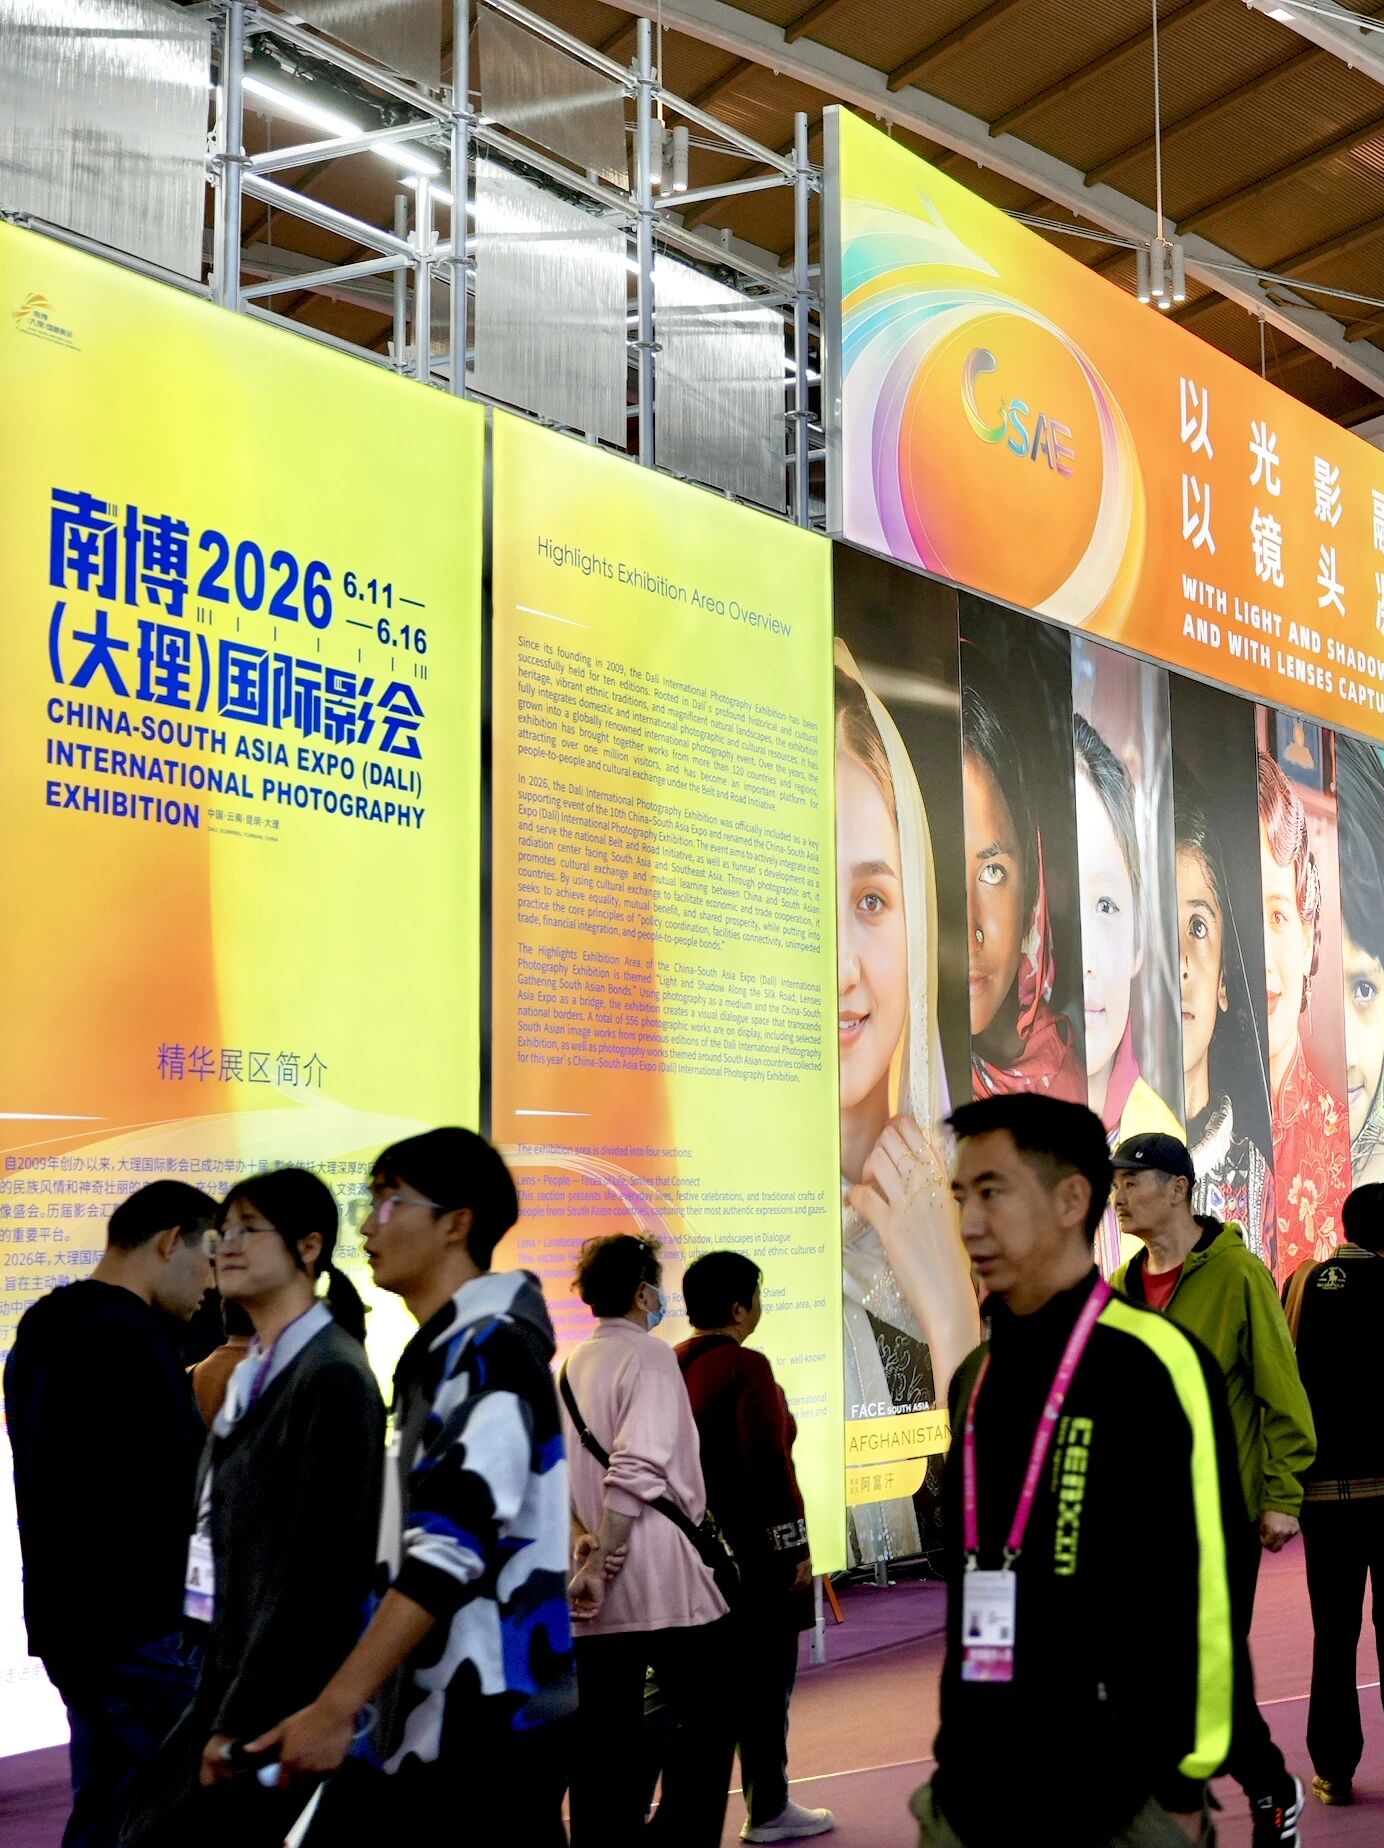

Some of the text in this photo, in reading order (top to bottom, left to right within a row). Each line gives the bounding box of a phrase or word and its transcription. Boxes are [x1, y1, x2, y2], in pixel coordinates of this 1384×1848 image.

[197, 529, 333, 629] 2026
[538, 536, 793, 638] Highlights Exhibition Area Overview
[1181, 573, 1228, 616] WITH
[1234, 597, 1283, 638] LIGHT
[1288, 621, 1321, 654] AND
[518, 636, 539, 651] Since
[543, 643, 552, 655] its
[557, 646, 591, 668] founding
[606, 660, 625, 676] 2009,
[629, 667, 641, 679] the
[645, 671, 658, 684] Dali
[663, 676, 706, 698] International
[710, 690, 751, 713] Photography
[755, 703, 786, 721] Exhibition
[788, 714, 799, 725] has
[802, 718, 817, 731] been
[1183, 613, 1221, 649] AND
[1227, 630, 1271, 669] WITH
[1277, 651, 1333, 693] LENSES
[47, 697, 423, 800] CHINA-SOUTH ASIA EXPO (DALI)
[518, 665, 817, 756] heritage, vibrant ethnic traditions, and magnificent natural landscapes, the exhibition
[47, 738, 425, 829] INTERNATIONAL PHOTOGRAPHY
[518, 710, 818, 797] exhibition has brought together works from more than 120 countries and regions,
[518, 726, 556, 747] attracting
[561, 739, 578, 749] over
[583, 744, 597, 753] one
[603, 745, 628, 761] million
[633, 753, 660, 770] visitors,
[666, 760, 679, 773] and
[683, 765, 695, 777] has
[700, 769, 726, 784] become
[744, 780, 775, 799] important
[779, 789, 806, 807] platform
[809, 797, 818, 808] for
[46, 780, 200, 828] EXHIBITION
[529, 774, 549, 790] 2026,
[553, 779, 565, 791] the
[568, 782, 583, 795] Dali
[586, 786, 633, 806] International
[636, 797, 681, 818] Photography
[684, 807, 717, 824] Exhibition
[720, 818, 732, 827] was
[735, 819, 762, 836] officially
[764, 826, 791, 841] included
[808, 837, 818, 850] key
[518, 942, 532, 954] The
[538, 945, 577, 962] Highlights
[582, 950, 619, 964] Exhibition
[624, 956, 640, 967] Area
[658, 960, 669, 971] the
[673, 962, 717, 977] China-South
[721, 969, 735, 980] Asia
[740, 971, 755, 985] Expo
[759, 974, 776, 987] (Dali)
[781, 977, 821, 992] International
[157, 1042, 328, 1088] 精华展区简介
[851, 1401, 929, 1418] FACE SOUTH ASIA
[861, 1473, 894, 1493] 阿富汗
